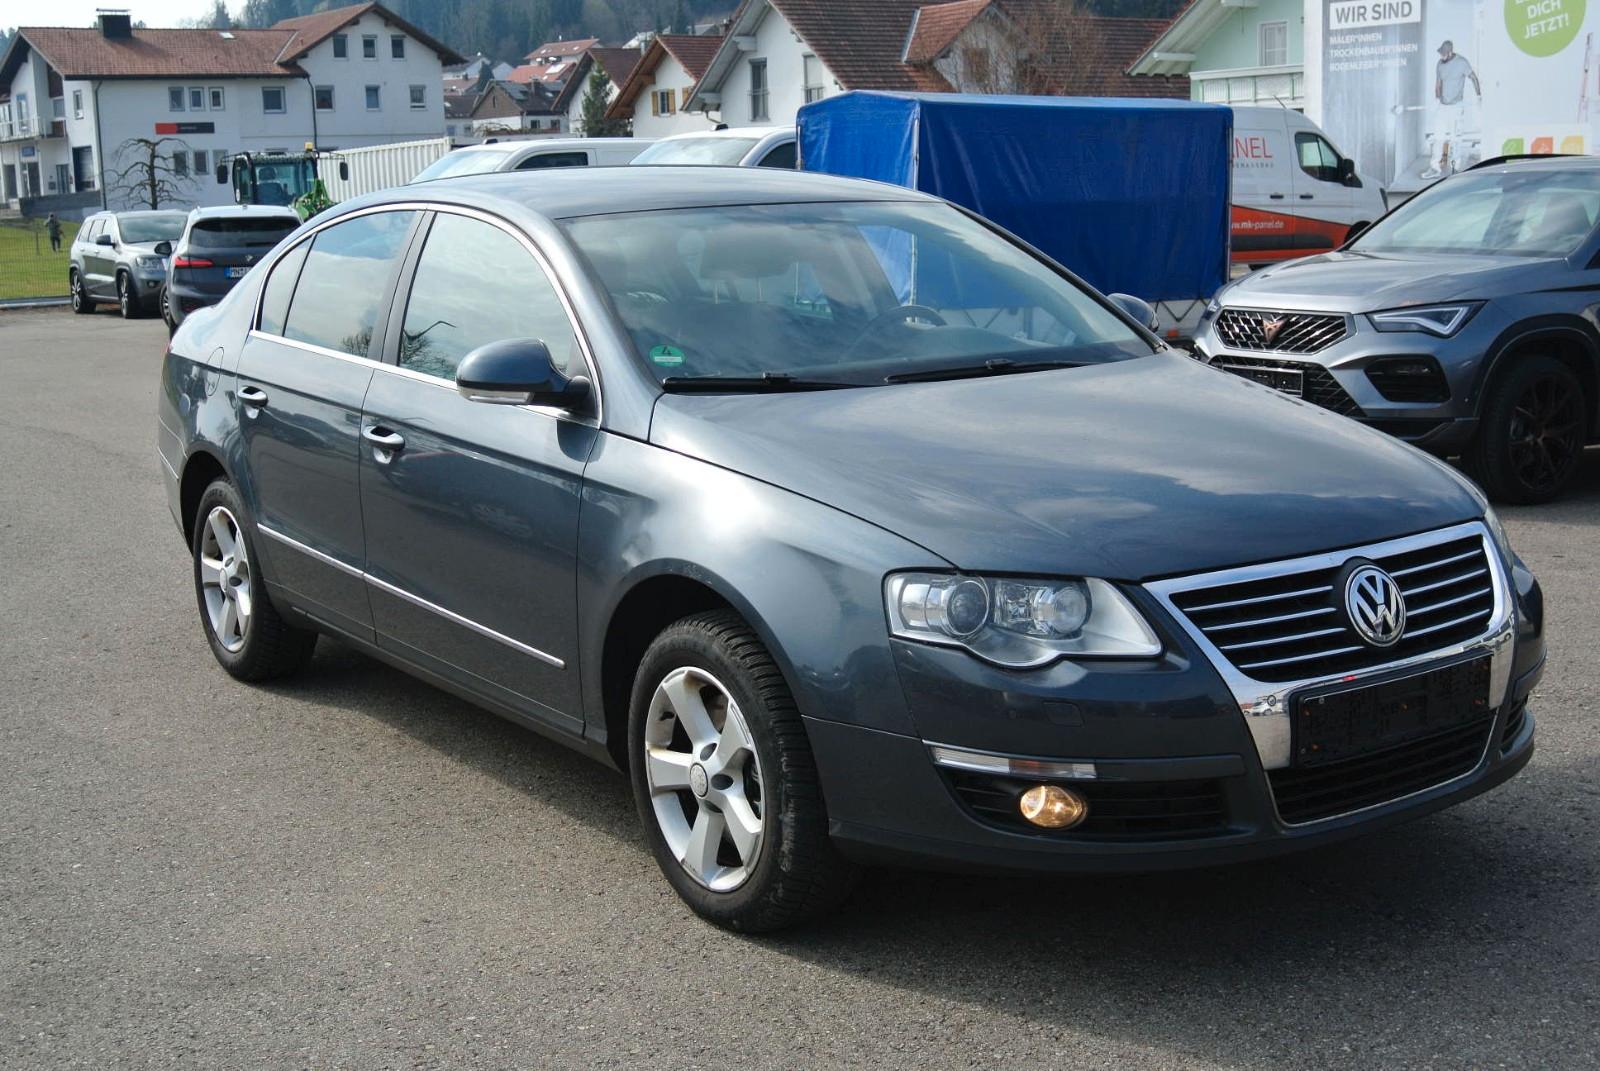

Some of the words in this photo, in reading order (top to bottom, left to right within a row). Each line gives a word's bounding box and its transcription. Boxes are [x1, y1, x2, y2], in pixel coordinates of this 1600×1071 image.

[1335, 5, 1367, 24] WIR
[1371, 1, 1412, 20] SIND
[1527, 0, 1561, 19] DICH
[1524, 12, 1569, 39] JETZT!
[1232, 137, 1273, 158] NEL
